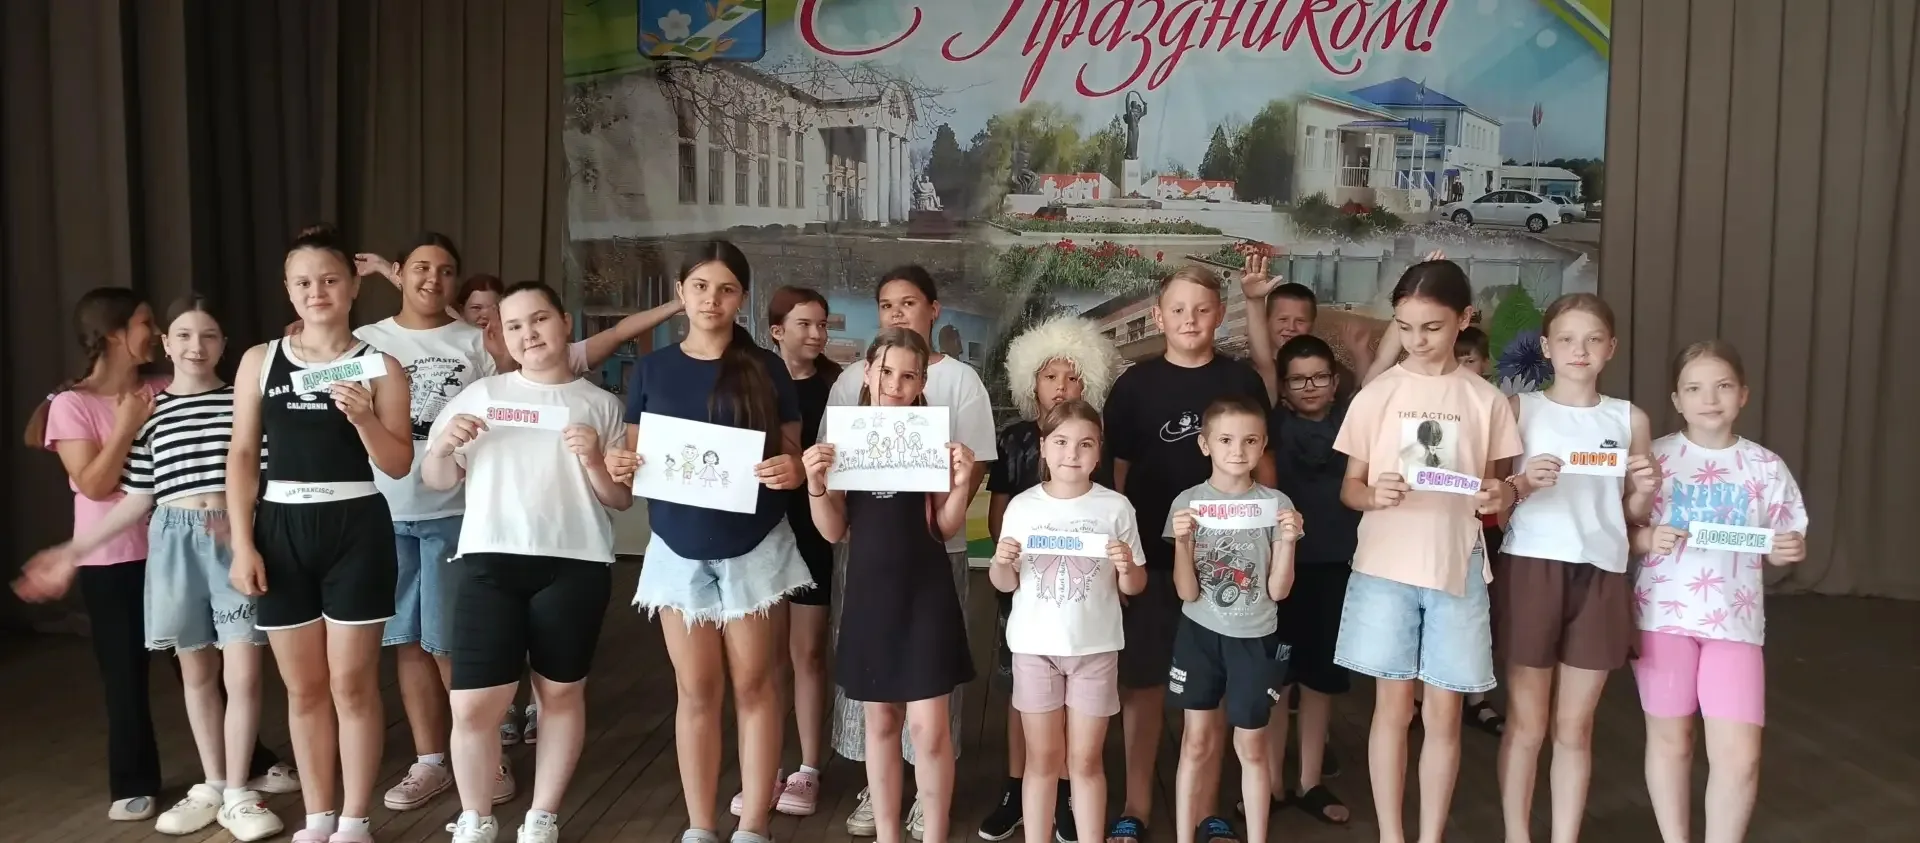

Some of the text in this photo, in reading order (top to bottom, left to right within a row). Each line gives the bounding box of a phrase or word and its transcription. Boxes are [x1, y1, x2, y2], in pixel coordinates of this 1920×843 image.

[413, 357, 461, 365] FANTASTIC
[302, 361, 364, 390] ДРУЖБА
[268, 384, 291, 398] SAN
[286, 402, 329, 411] CALIFORNIA
[487, 406, 540, 424] ЗАБОТА
[1397, 411, 1461, 422] THE ACTION
[1570, 451, 1618, 466] ОПОРА
[1416, 471, 1480, 491] СЧАСТЬЕ
[297, 486, 335, 496] FRANCISCO
[1198, 503, 1262, 519] РАДОСТЬ
[1027, 534, 1084, 550] ЛЮБОВЬ
[1696, 528, 1767, 548] ДОВЕРИЕ
